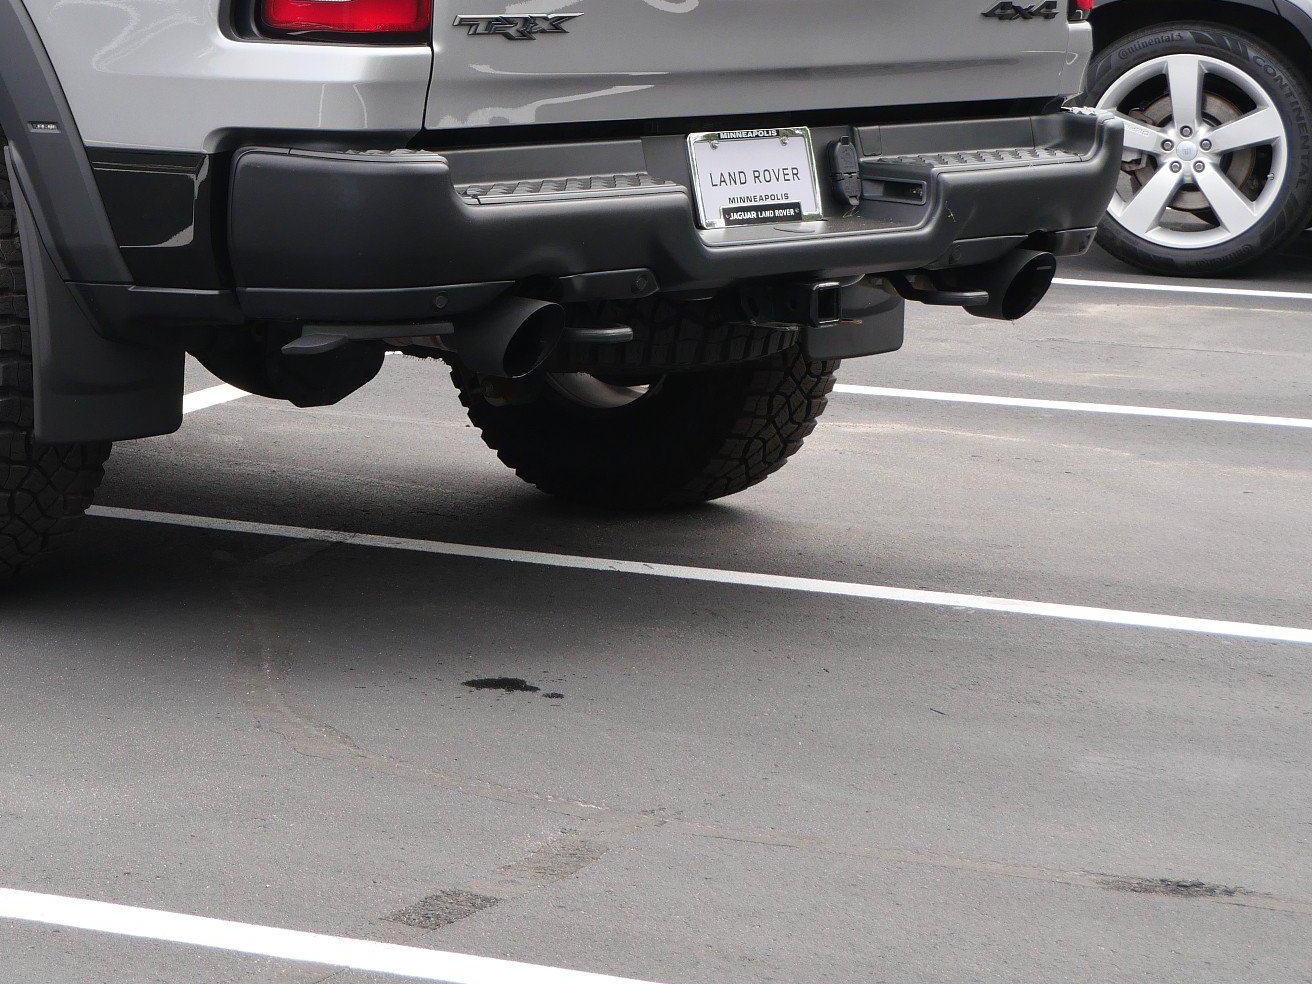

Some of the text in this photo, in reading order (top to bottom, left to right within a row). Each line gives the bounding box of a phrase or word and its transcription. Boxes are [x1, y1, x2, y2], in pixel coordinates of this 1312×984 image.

[981, 0, 1059, 21] 4x4
[452, 12, 585, 41] TRX
[719, 130, 778, 140] MINNEAPOLIS
[709, 167, 801, 188] LAND ROVER
[728, 192, 790, 205] MINNEAPOLIS
[729, 208, 795, 221] JAGUAR LAND ROVER
